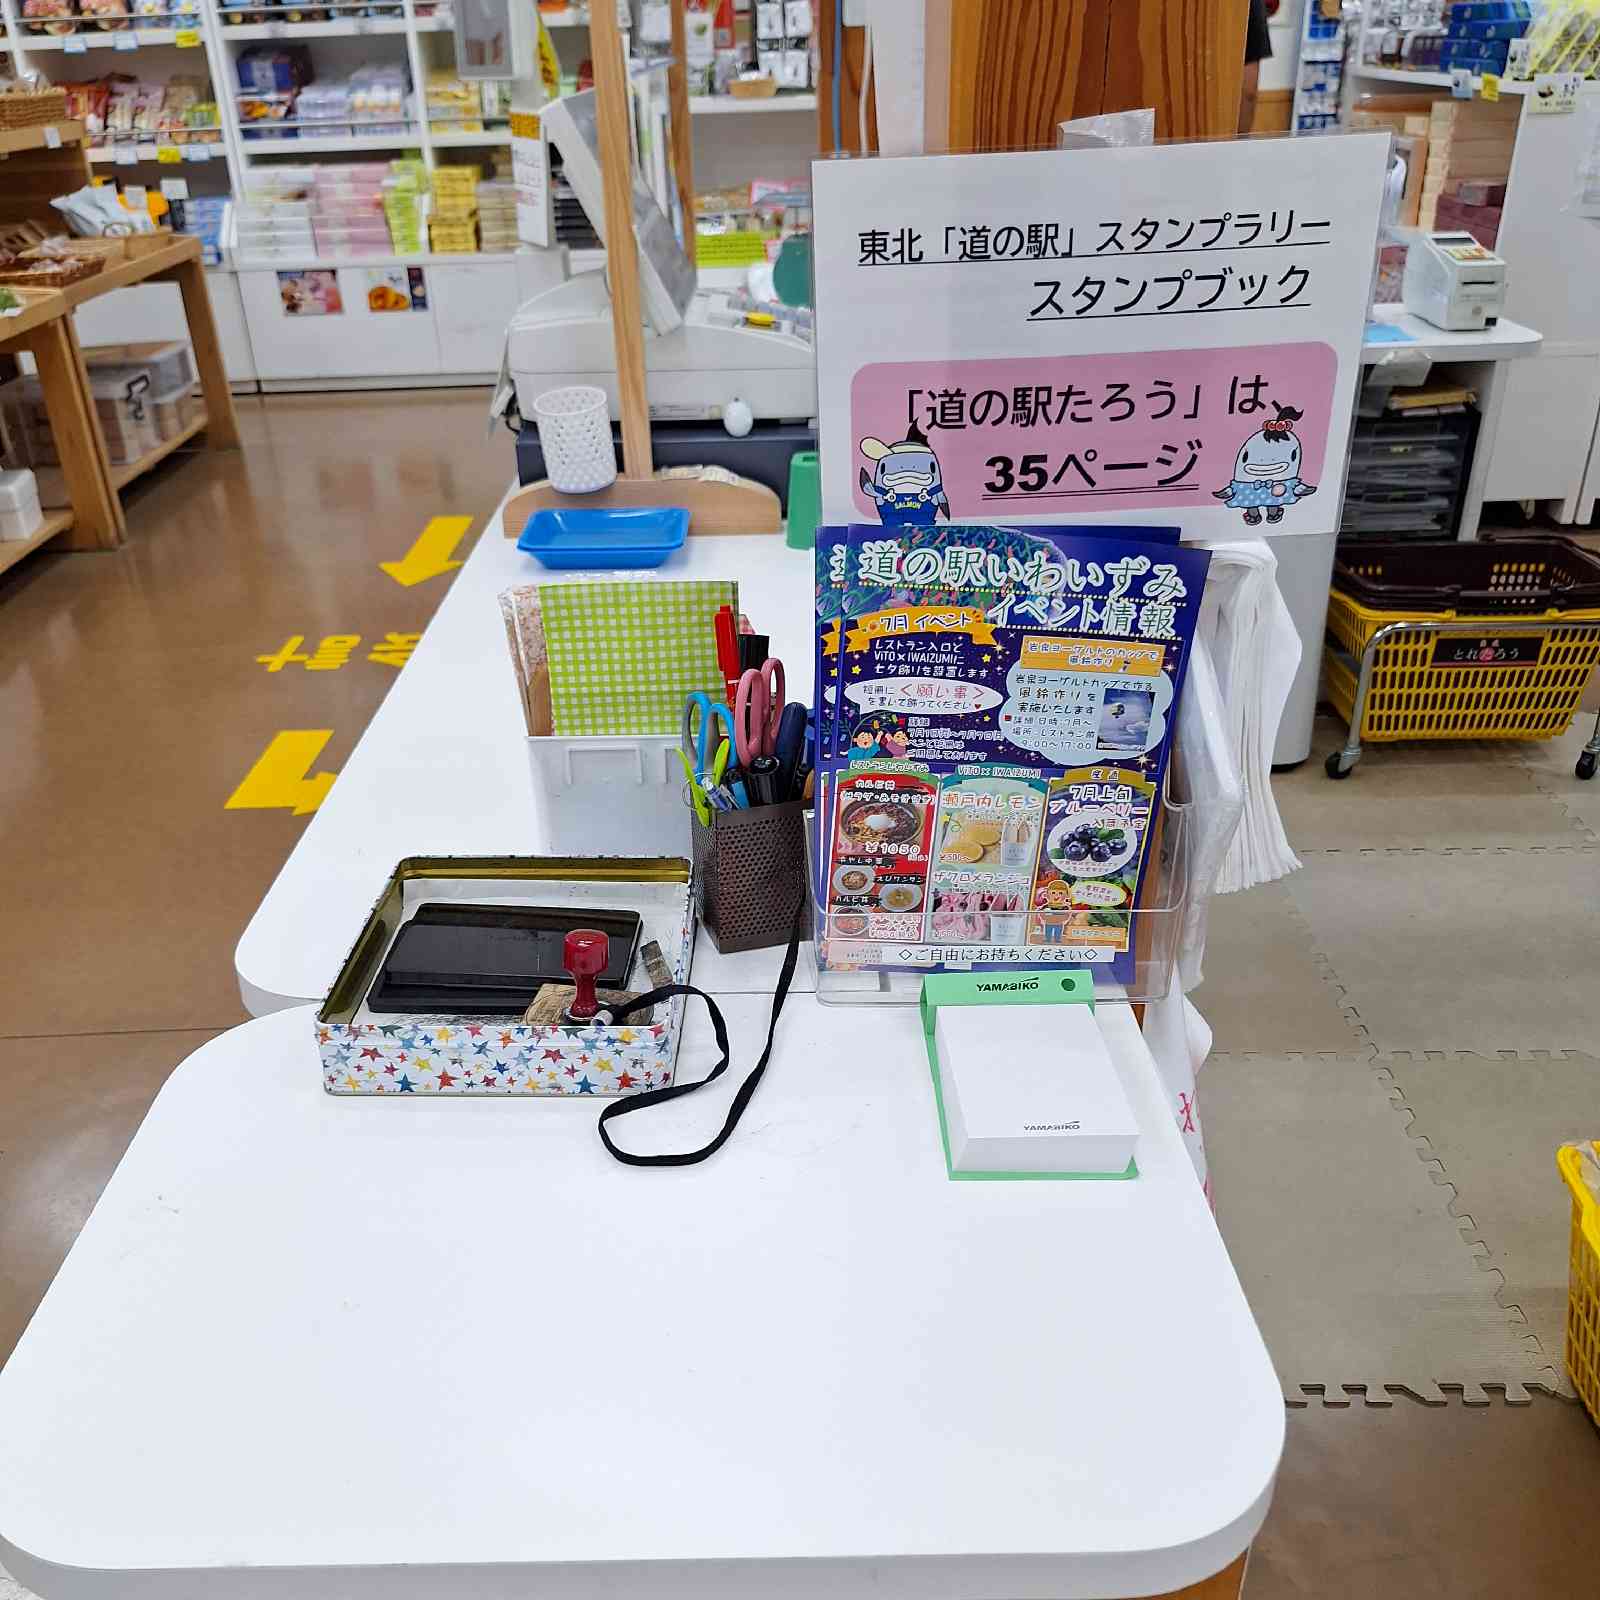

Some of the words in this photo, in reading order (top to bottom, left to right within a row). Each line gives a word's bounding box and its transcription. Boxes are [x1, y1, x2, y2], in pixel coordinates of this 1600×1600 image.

[858, 210, 1331, 264] 東北「道の駅」スタンプラリー
[1030, 265, 1311, 317] スタンプブック
[984, 439, 1203, 493] 35ページ
[861, 540, 1187, 604] 道の駅いわいずみ
[880, 615, 909, 632] 7月
[916, 613, 972, 628] イベント
[989, 596, 1177, 636] イベント情報
[876, 639, 963, 653] レストラン入口と
[875, 663, 989, 678] 七夕飾りを設置します
[1018, 703, 1097, 715] 実施いたします
[942, 793, 1041, 809] 瀬戸内レモン
[1069, 784, 1132, 802] 7月上旬
[976, 976, 1040, 992] YAMABIKO
[1023, 1120, 1081, 1131] YAMABIKO
